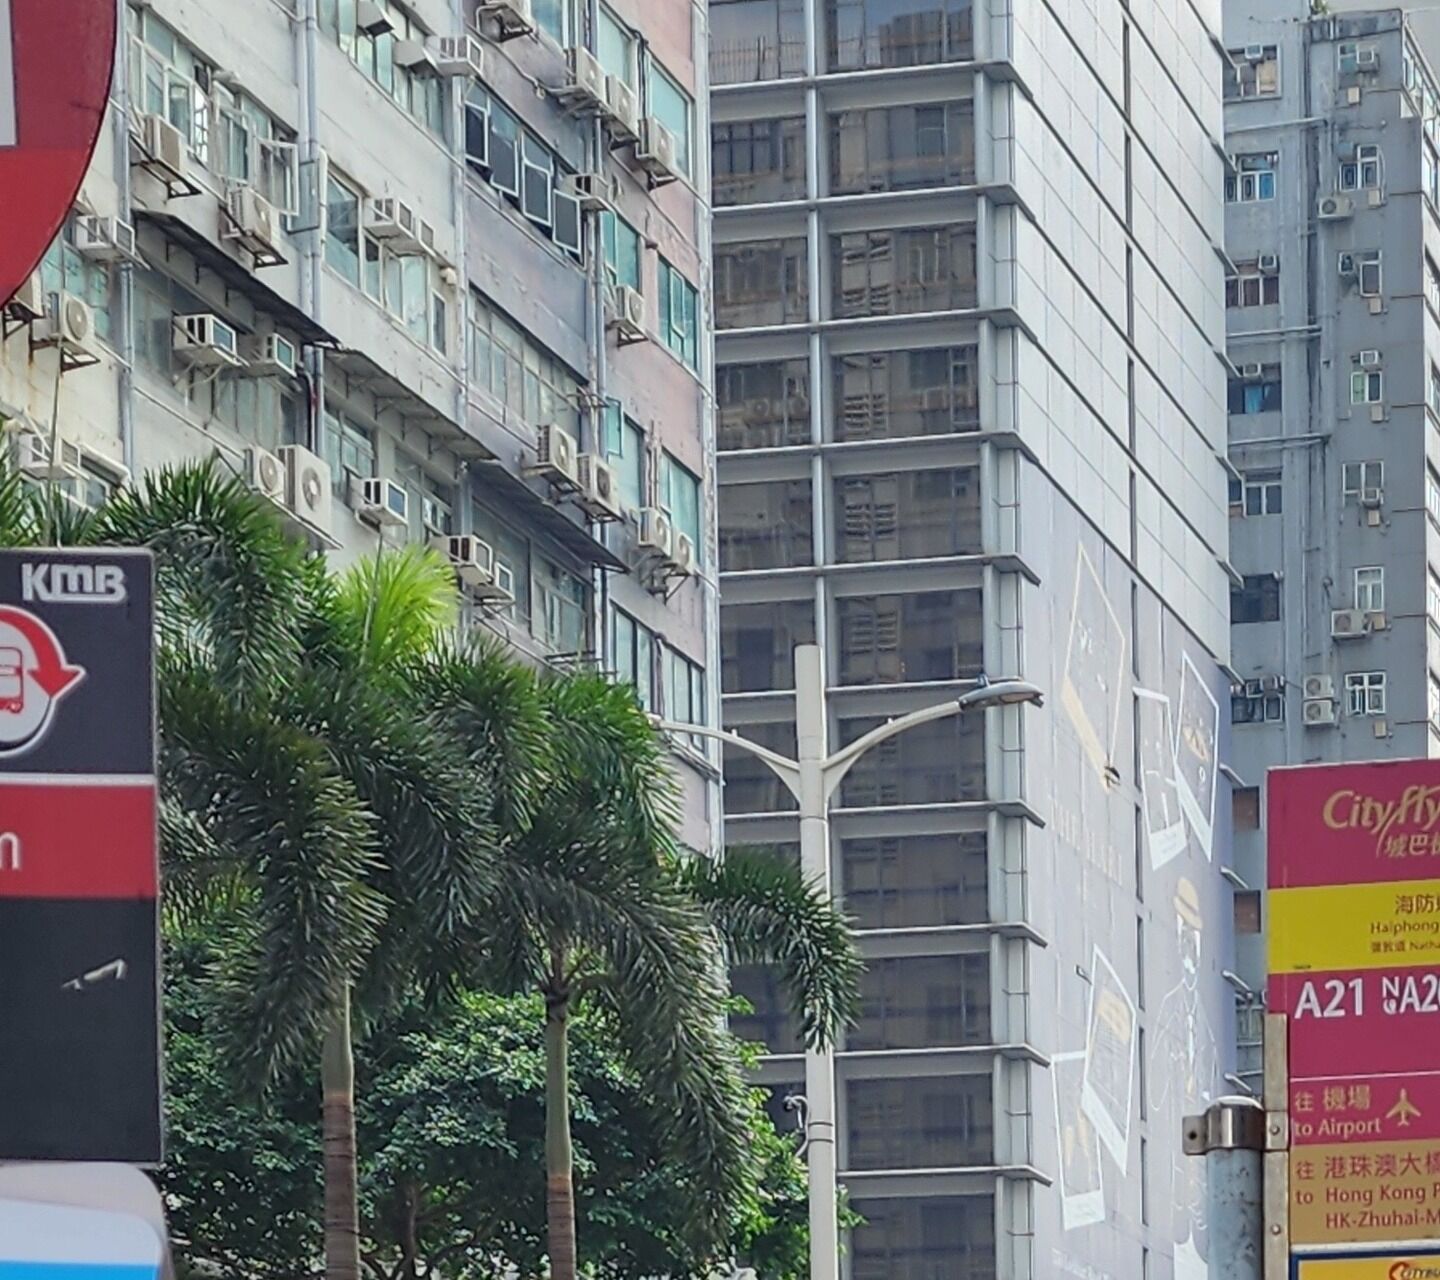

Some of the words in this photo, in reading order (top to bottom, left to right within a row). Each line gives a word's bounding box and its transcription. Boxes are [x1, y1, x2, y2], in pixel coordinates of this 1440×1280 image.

[22, 562, 127, 602] KMB
[1370, 919, 1440, 937] Haiphong
[1294, 977, 1363, 1020] A21
[1295, 1090, 1314, 1113] 往
[1322, 1084, 1372, 1112] 機場
[1294, 1118, 1313, 1137] to
[1318, 1116, 1382, 1141] Airport
[1296, 1160, 1315, 1180] 往
[1296, 1189, 1314, 1205] to
[1325, 1186, 1374, 1207] Hong
[1379, 1183, 1426, 1205] Kong
